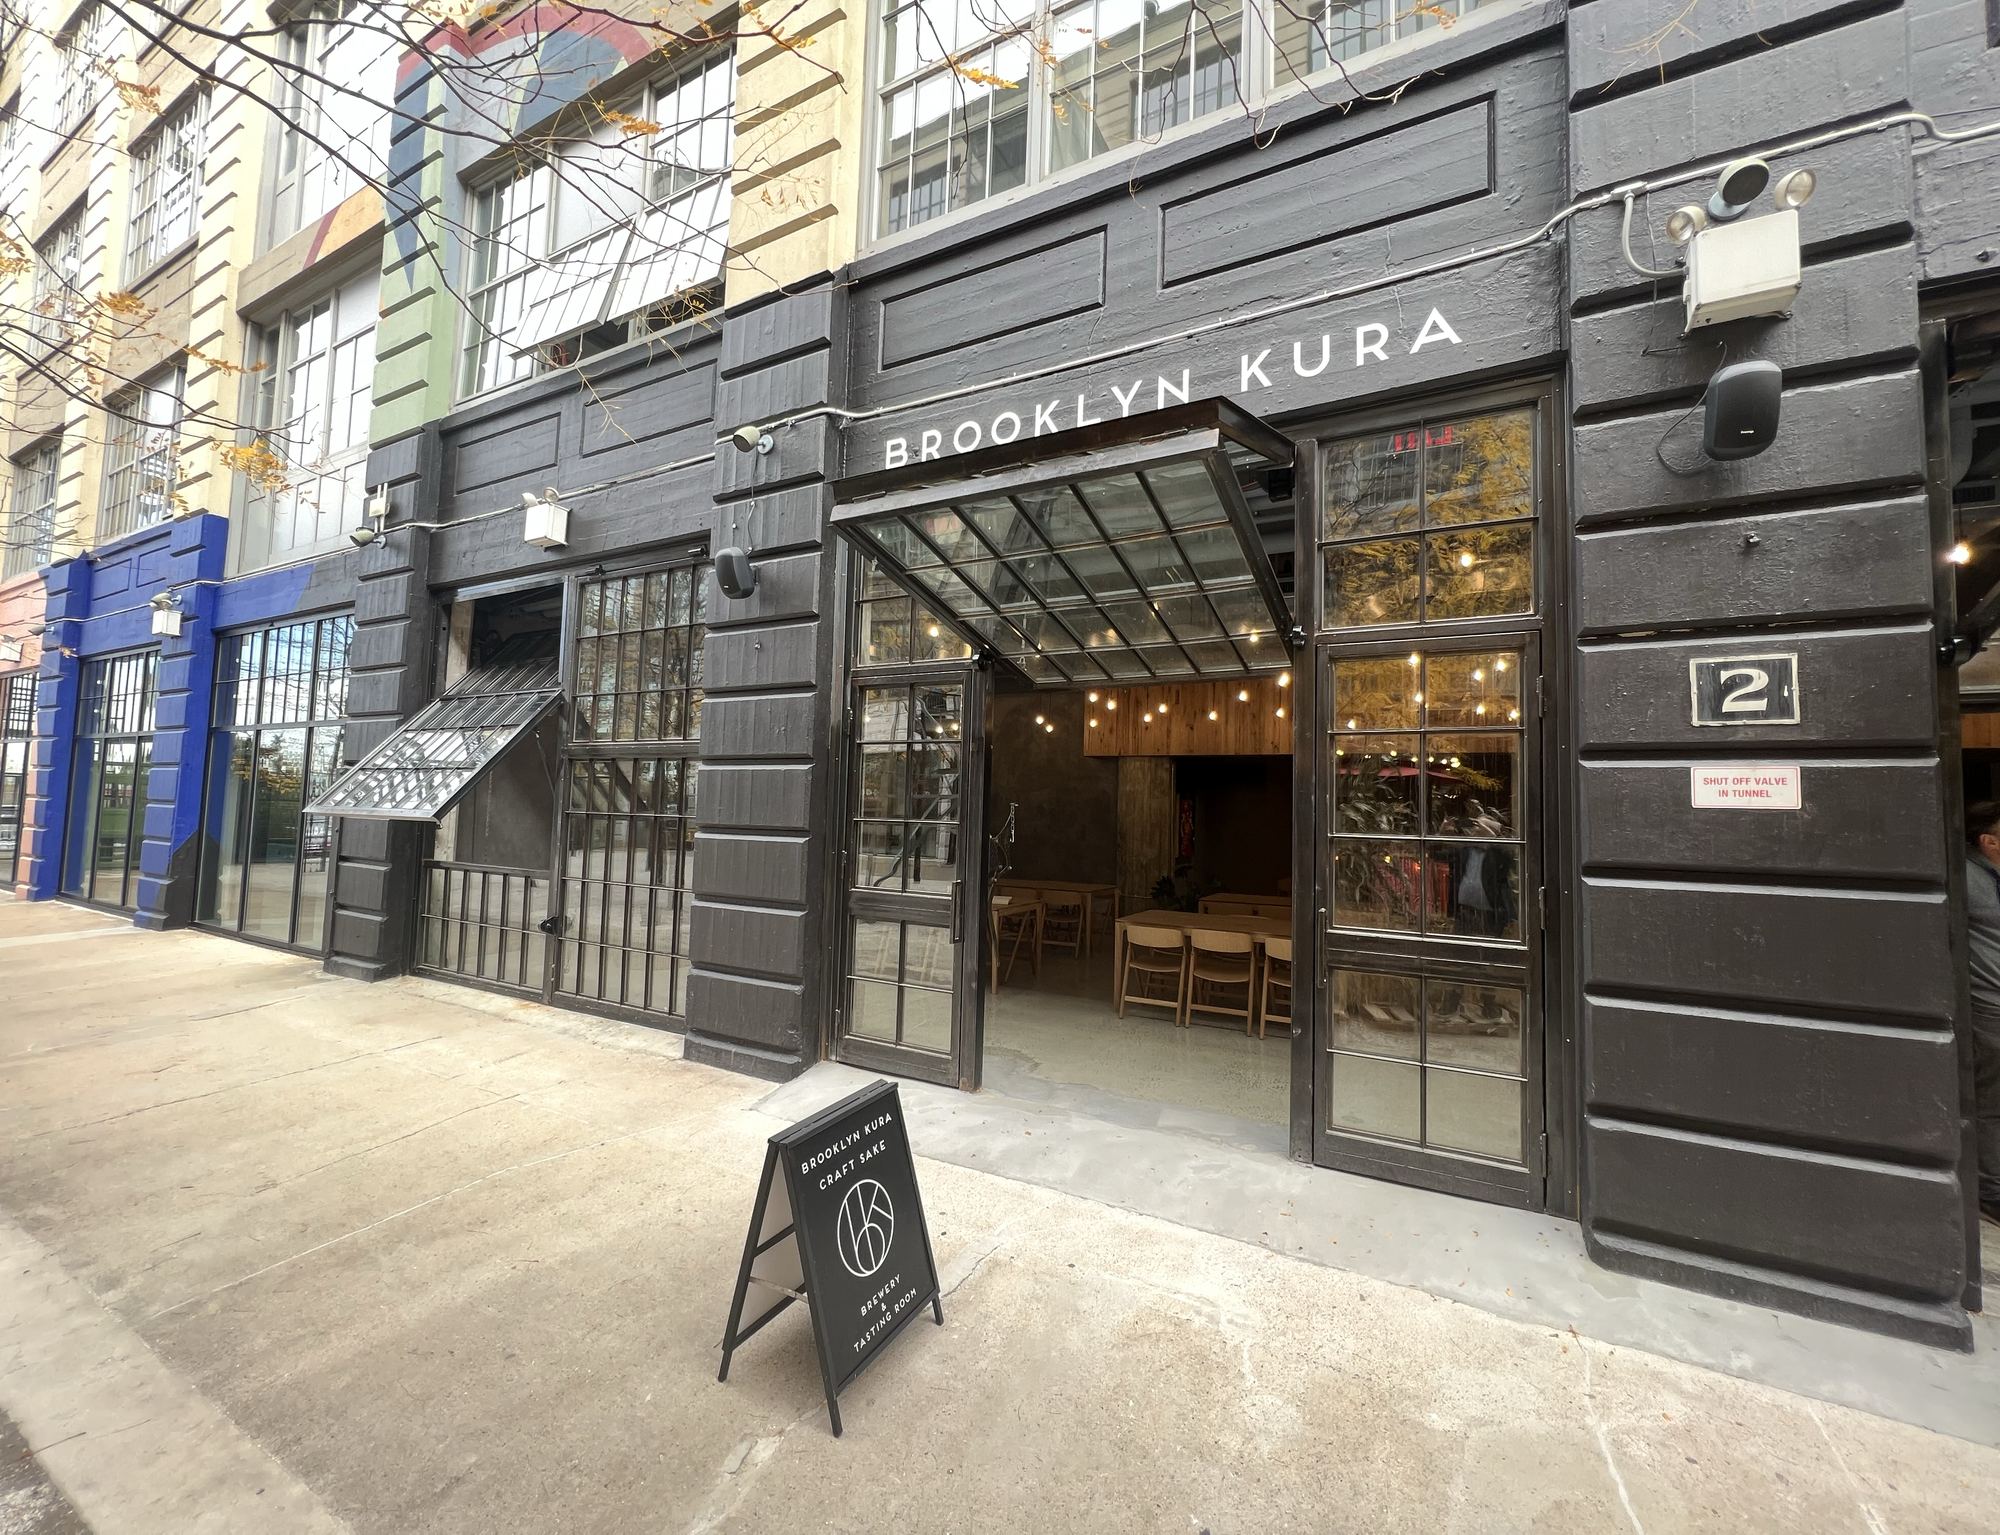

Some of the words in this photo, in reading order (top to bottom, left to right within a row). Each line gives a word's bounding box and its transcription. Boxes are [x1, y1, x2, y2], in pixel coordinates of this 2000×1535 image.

[885, 368, 1190, 470] BROOKLYN
[1240, 306, 1463, 393] KURA
[1720, 668, 1769, 713] 2
[1703, 777, 1729, 786] SHUT
[1732, 777, 1751, 786] OFF
[1755, 777, 1788, 786] VALVE
[1718, 789, 1729, 798] IN
[1732, 789, 1772, 798] TUNNEL
[801, 1130, 861, 1175] BROOKLYN
[864, 1112, 893, 1136] KURA
[819, 1158, 855, 1190] CRAFT
[859, 1139, 887, 1164] SAKE
[860, 1273, 901, 1316] BREWERY
[880, 1302, 887, 1312] &
[853, 1311, 892, 1352] TASTING
[894, 1288, 917, 1313] ROOM
